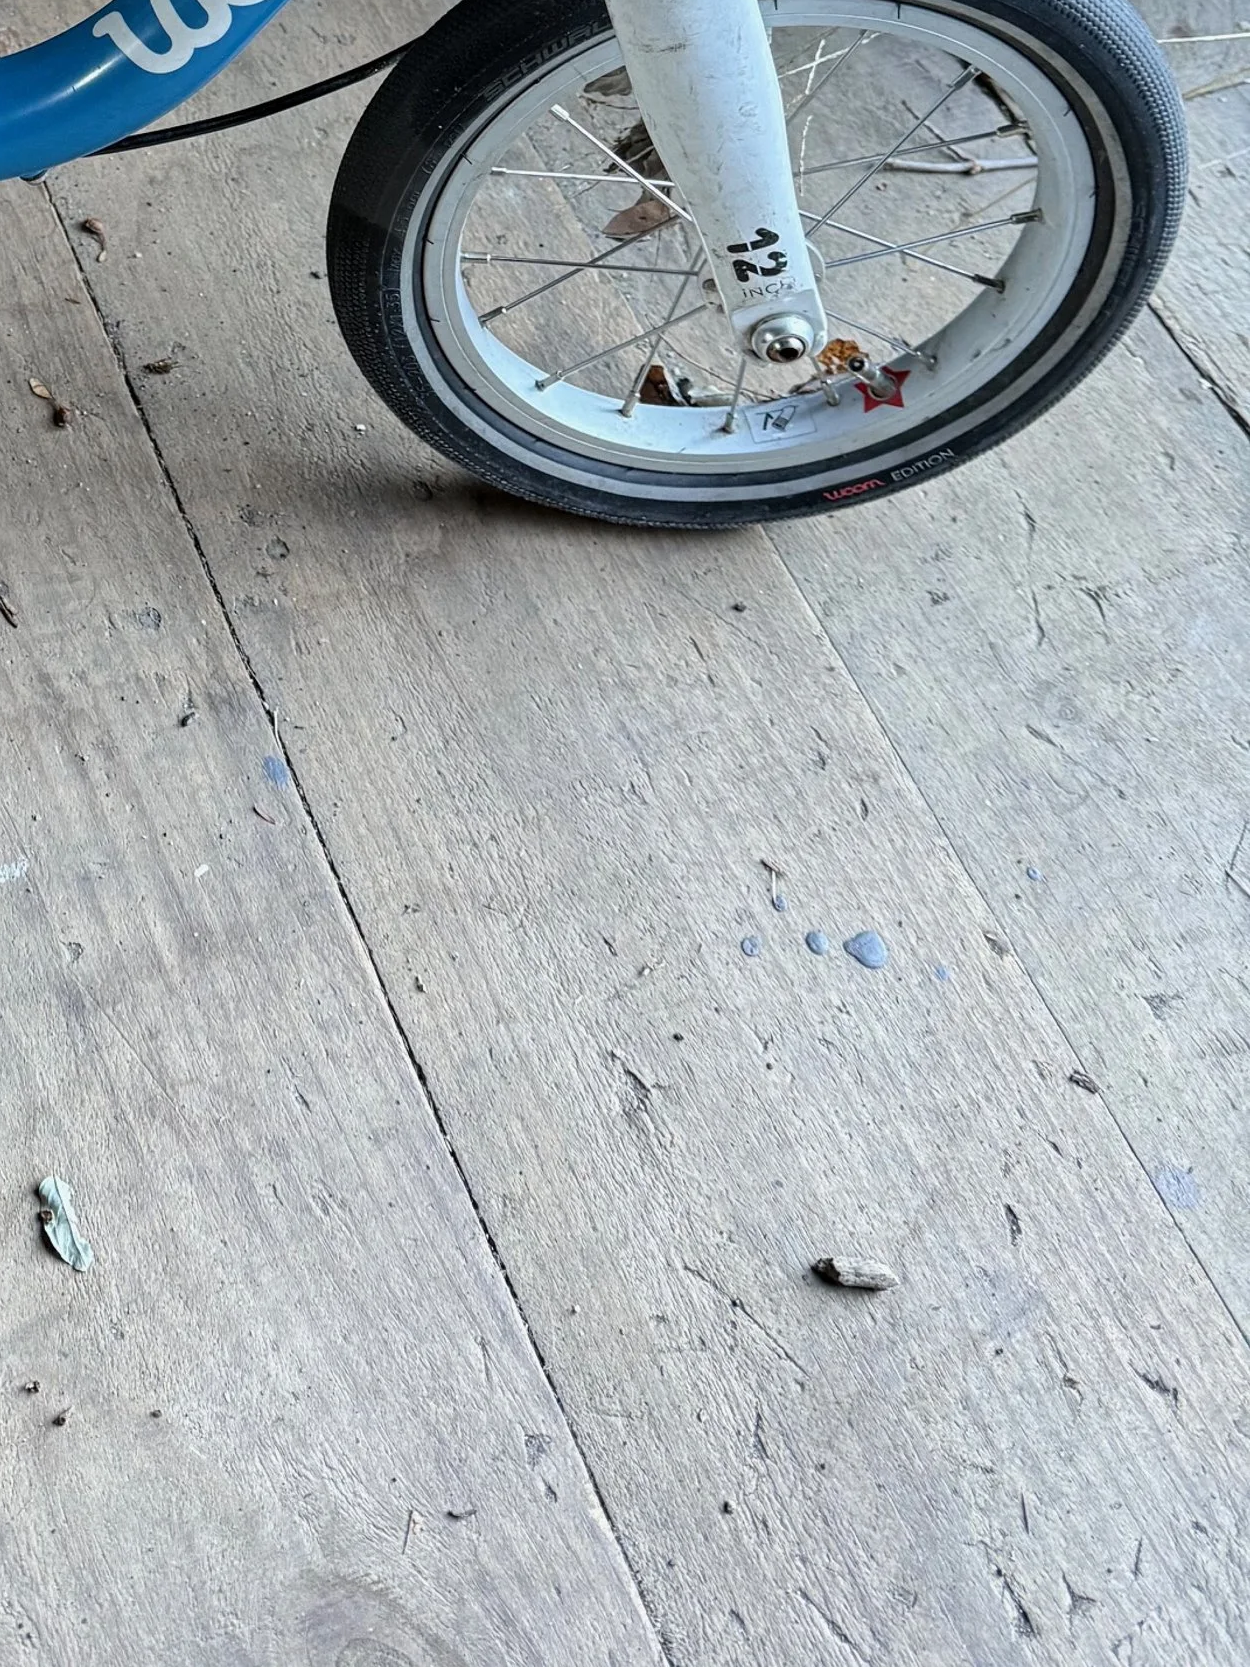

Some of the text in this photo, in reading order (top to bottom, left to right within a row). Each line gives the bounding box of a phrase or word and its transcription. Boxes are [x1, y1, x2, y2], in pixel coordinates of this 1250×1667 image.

[482, 20, 614, 102] SCHWAL
[726, 227, 788, 283] 12
[822, 447, 956, 501] woom EDITION
